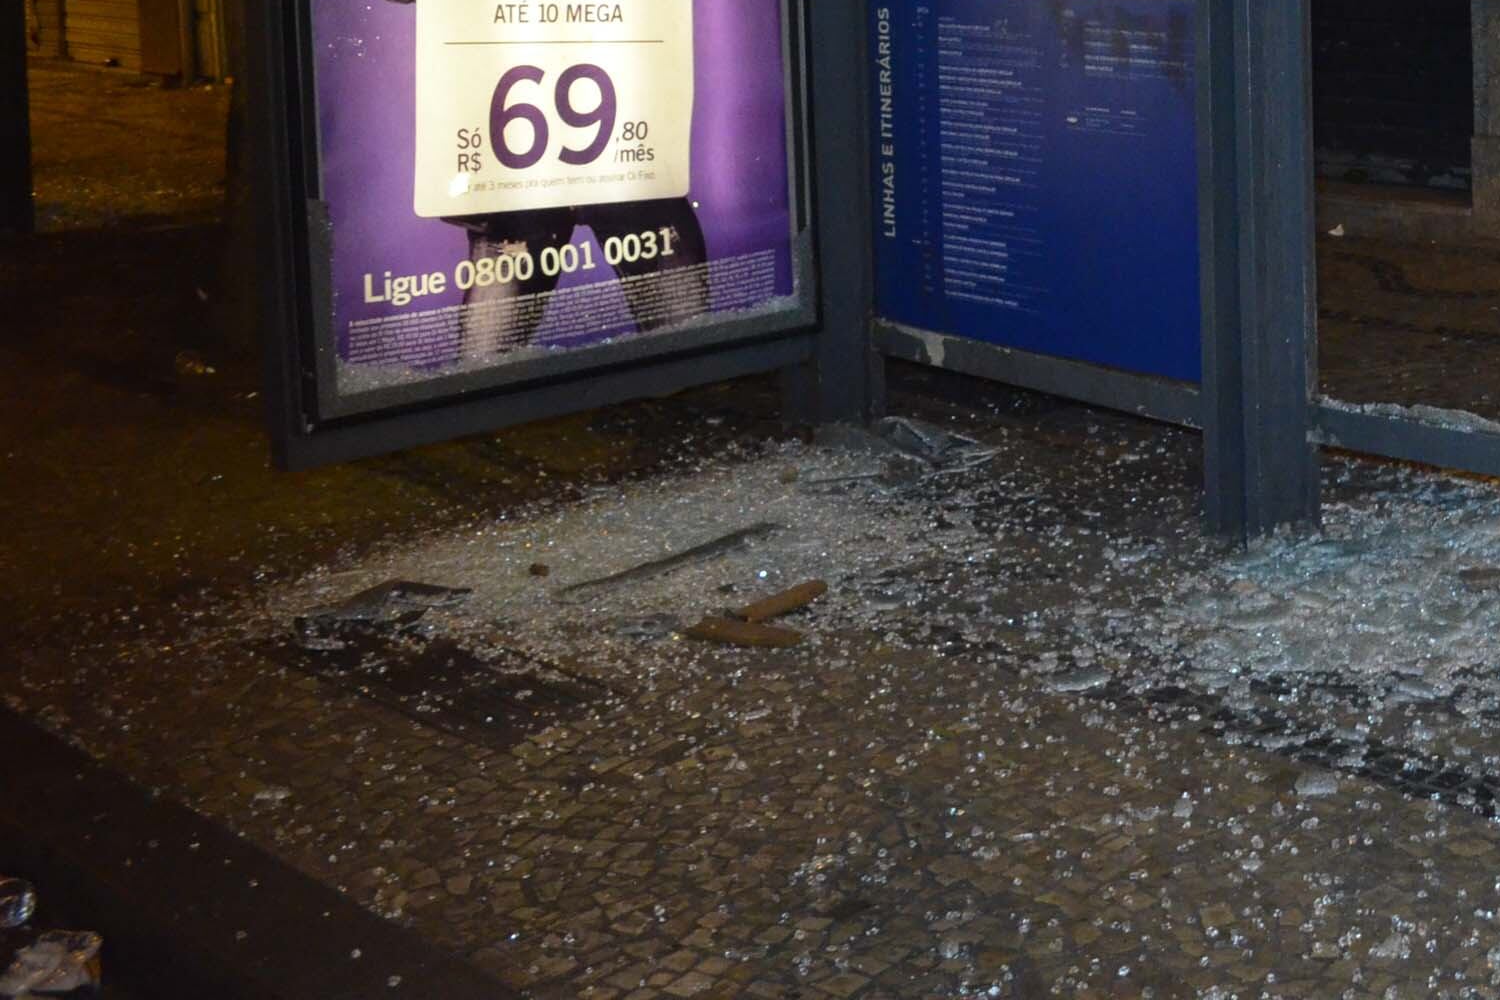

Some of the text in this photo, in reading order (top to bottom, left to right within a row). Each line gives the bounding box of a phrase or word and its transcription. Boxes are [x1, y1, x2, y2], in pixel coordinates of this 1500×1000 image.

[493, 0, 623, 24] ATÉ 10 MEGA
[456, 127, 482, 150] Só
[488, 63, 617, 169] 69
[875, 7, 896, 238] LINHAS E ITINERÁRIOS
[457, 152, 482, 175] R$
[363, 229, 674, 305] Ligue 0800 001 0031
